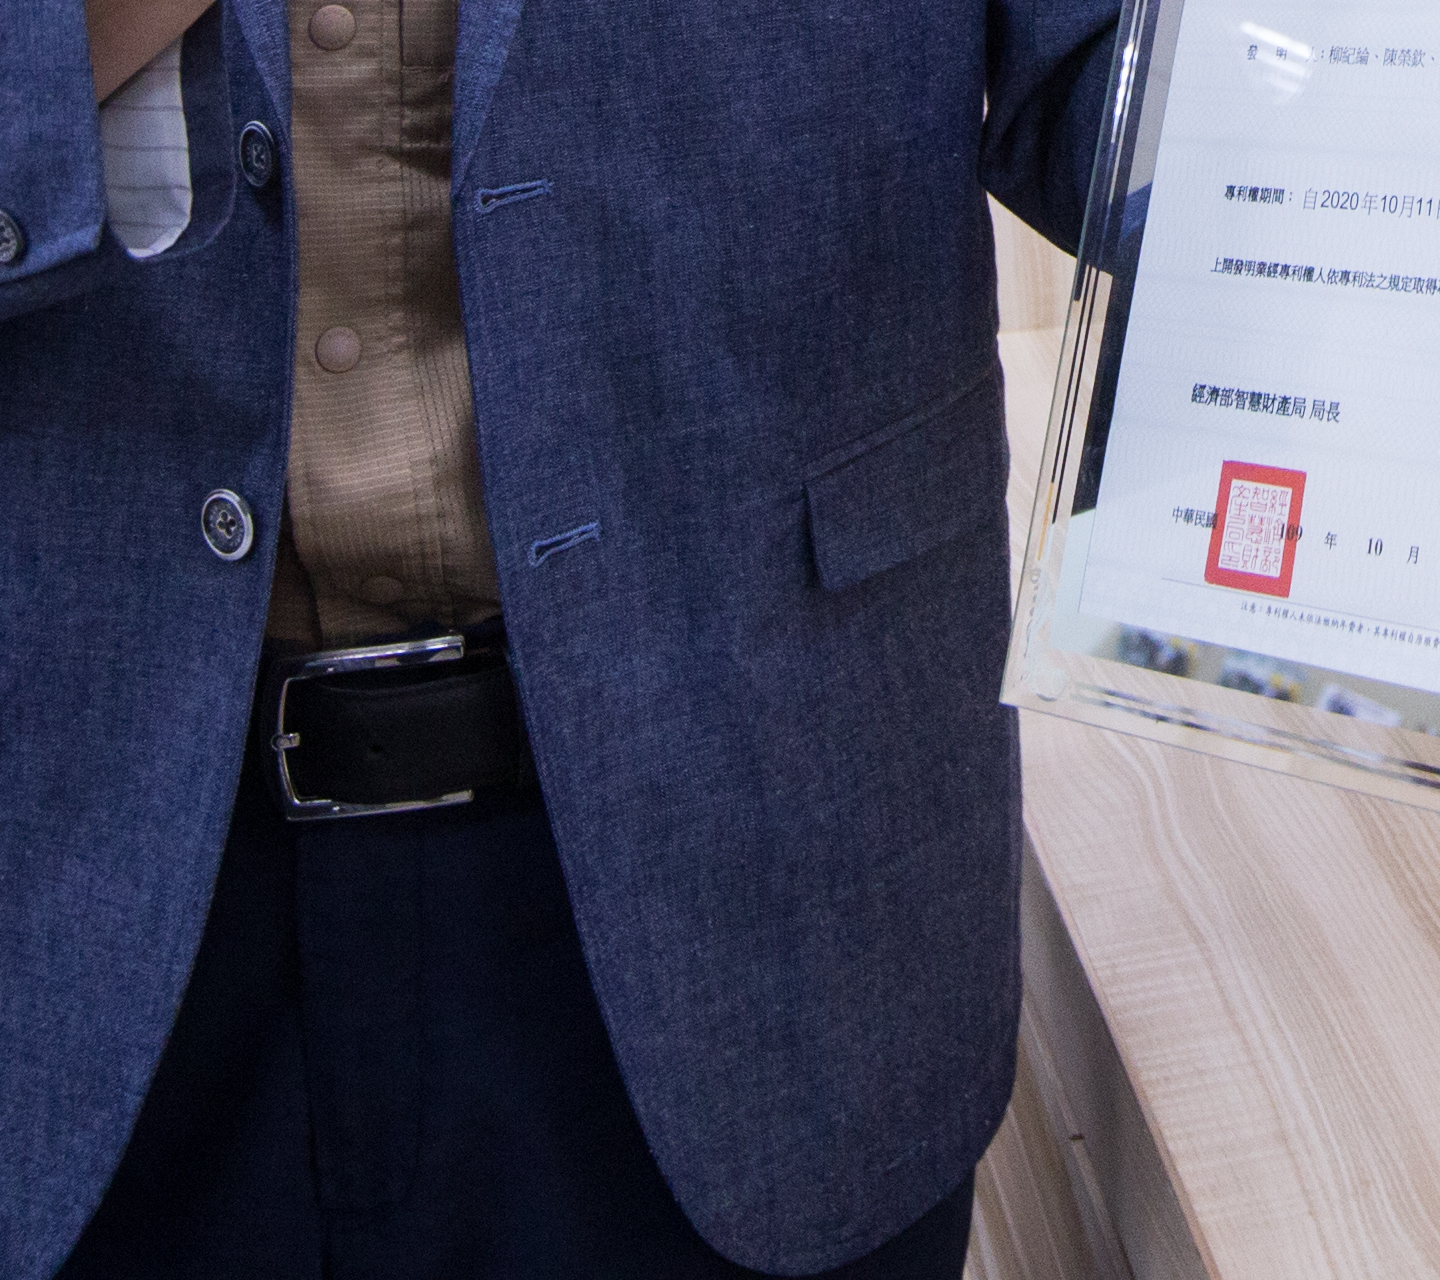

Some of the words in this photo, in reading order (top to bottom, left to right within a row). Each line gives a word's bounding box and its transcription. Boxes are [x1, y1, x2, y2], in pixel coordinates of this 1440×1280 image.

[1309, 398, 1341, 423] 局長
[1324, 530, 1338, 550] 年
[1366, 538, 1383, 557] 10
[1406, 545, 1420, 565] 月
